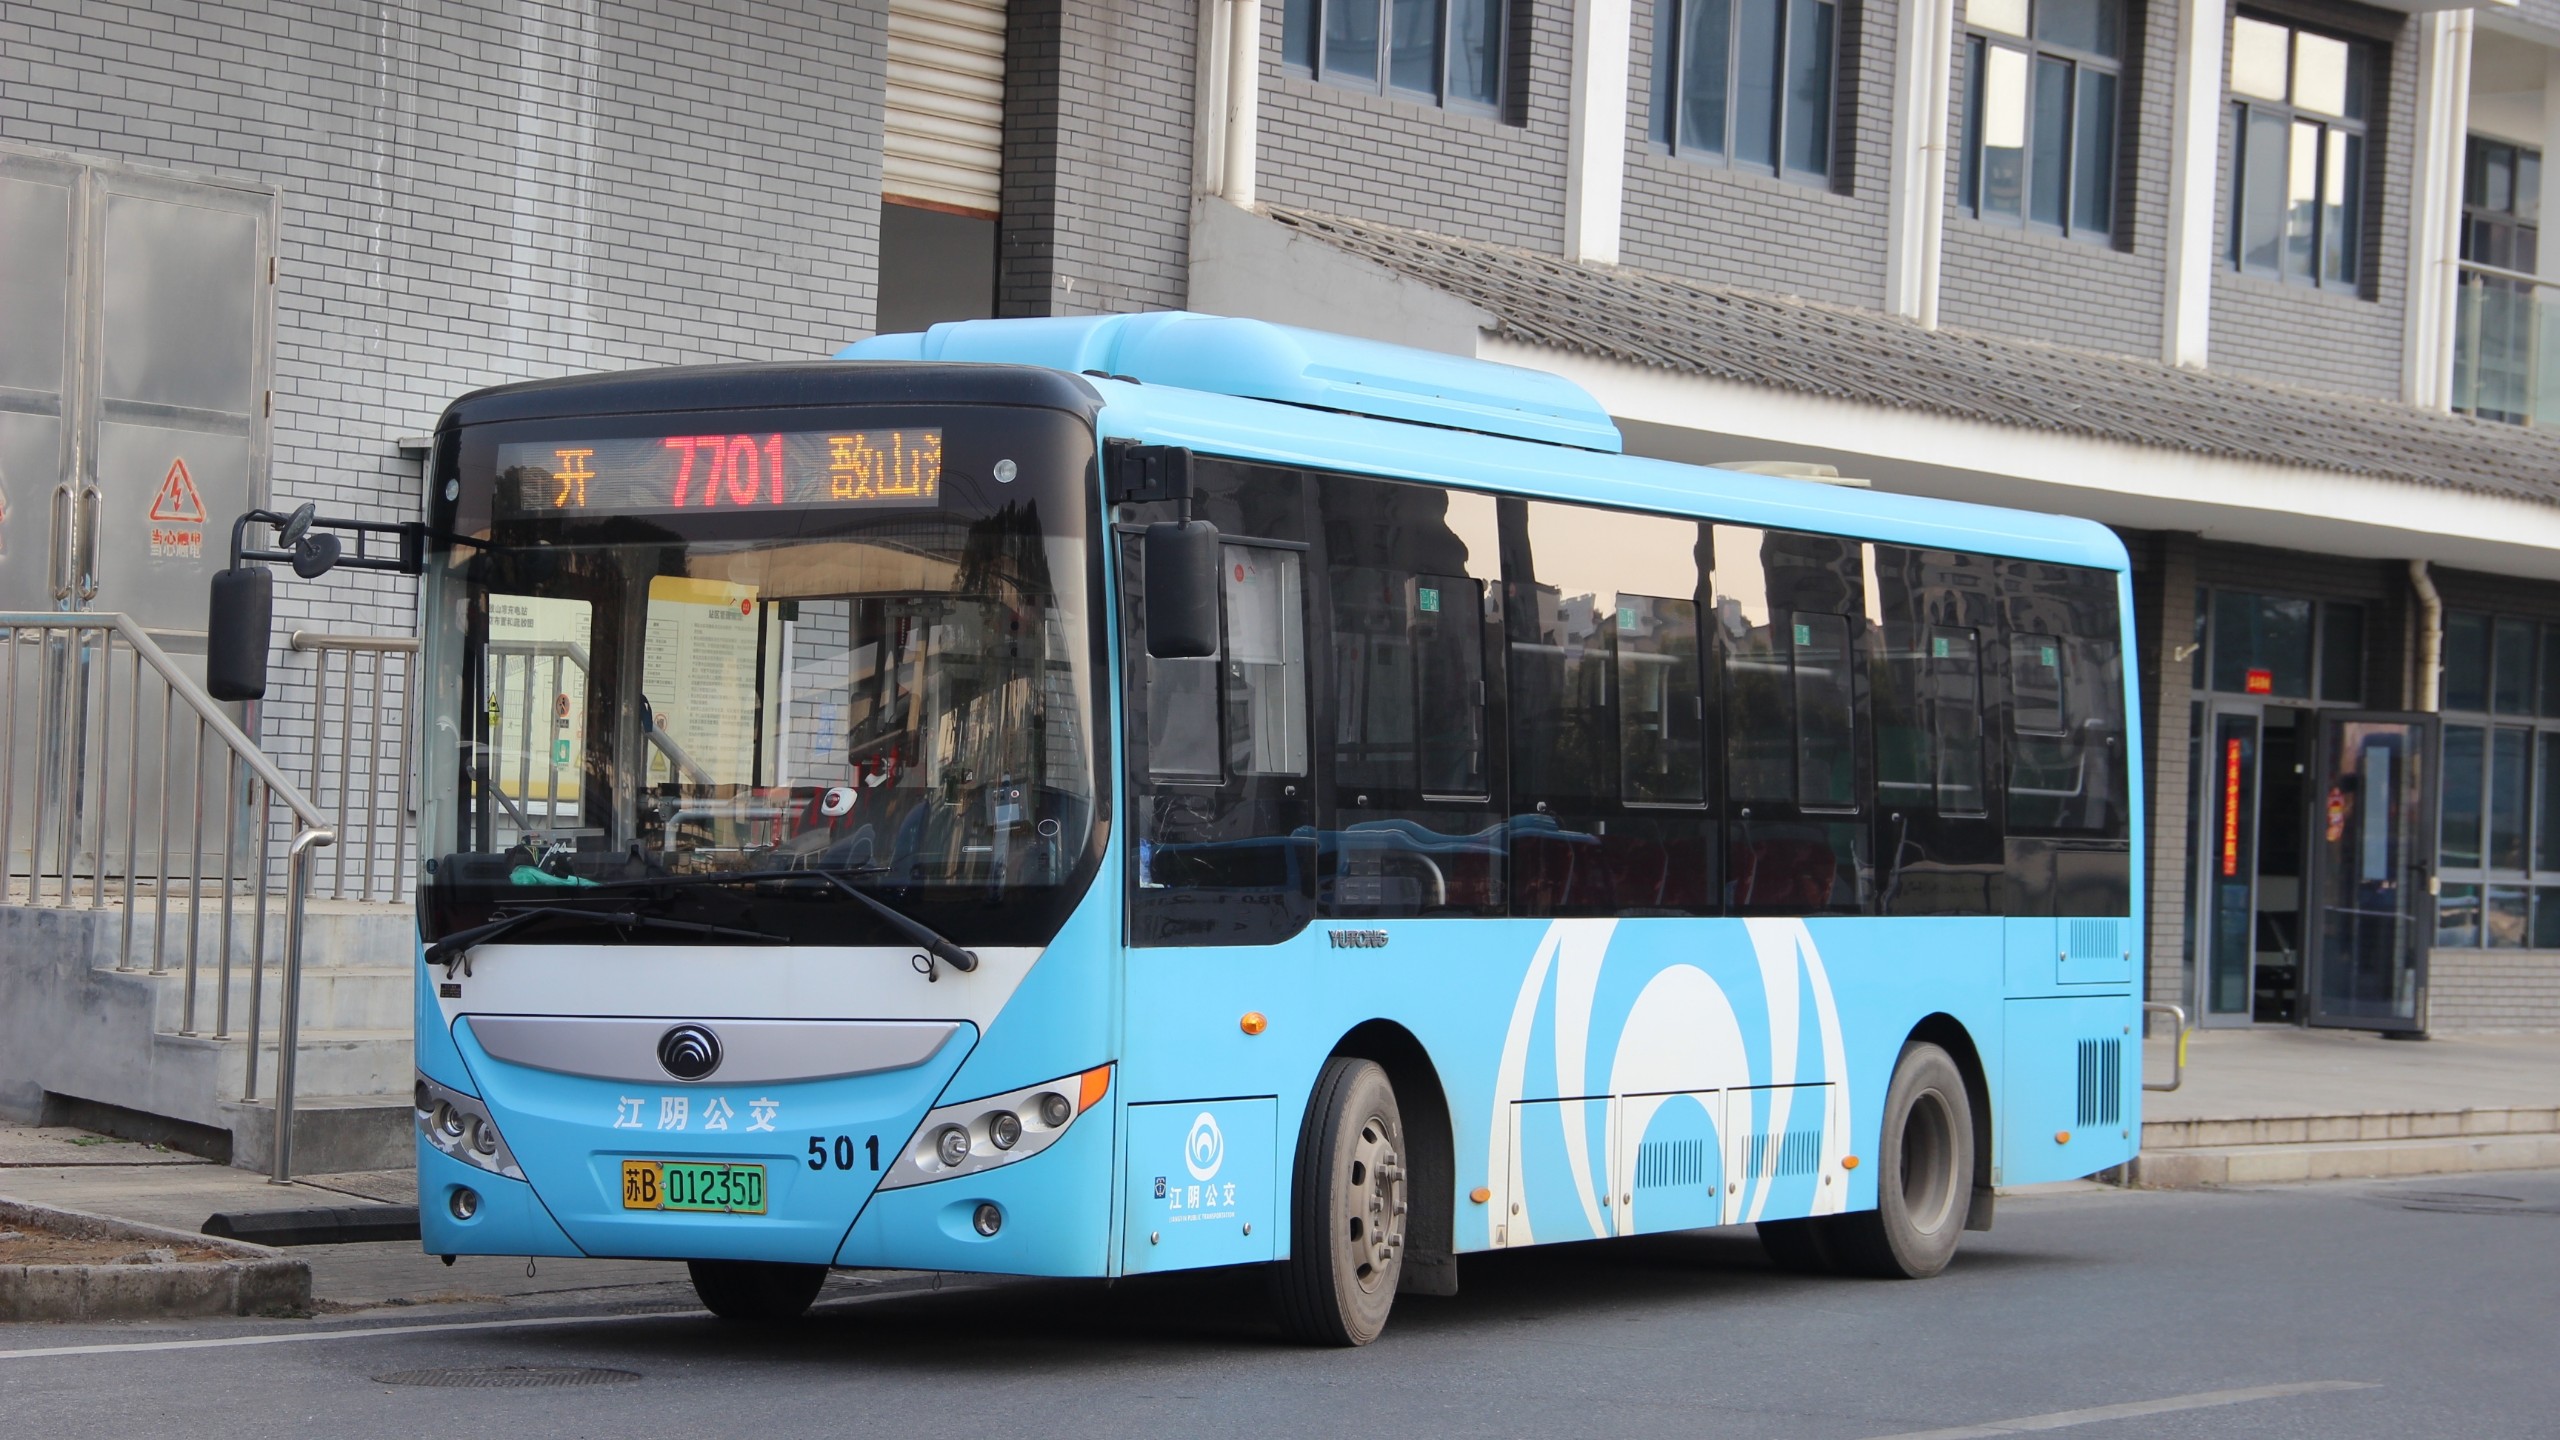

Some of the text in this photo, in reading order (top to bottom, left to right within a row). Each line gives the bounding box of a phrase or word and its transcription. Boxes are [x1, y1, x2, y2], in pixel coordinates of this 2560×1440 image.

[553, 449, 595, 507] 开
[664, 434, 783, 507] 7701
[1328, 929, 1389, 949] YUTONG
[613, 1096, 780, 1132] 江阴公交
[807, 1135, 880, 1171] 501
[1169, 1182, 1236, 1210] 江阴公交
